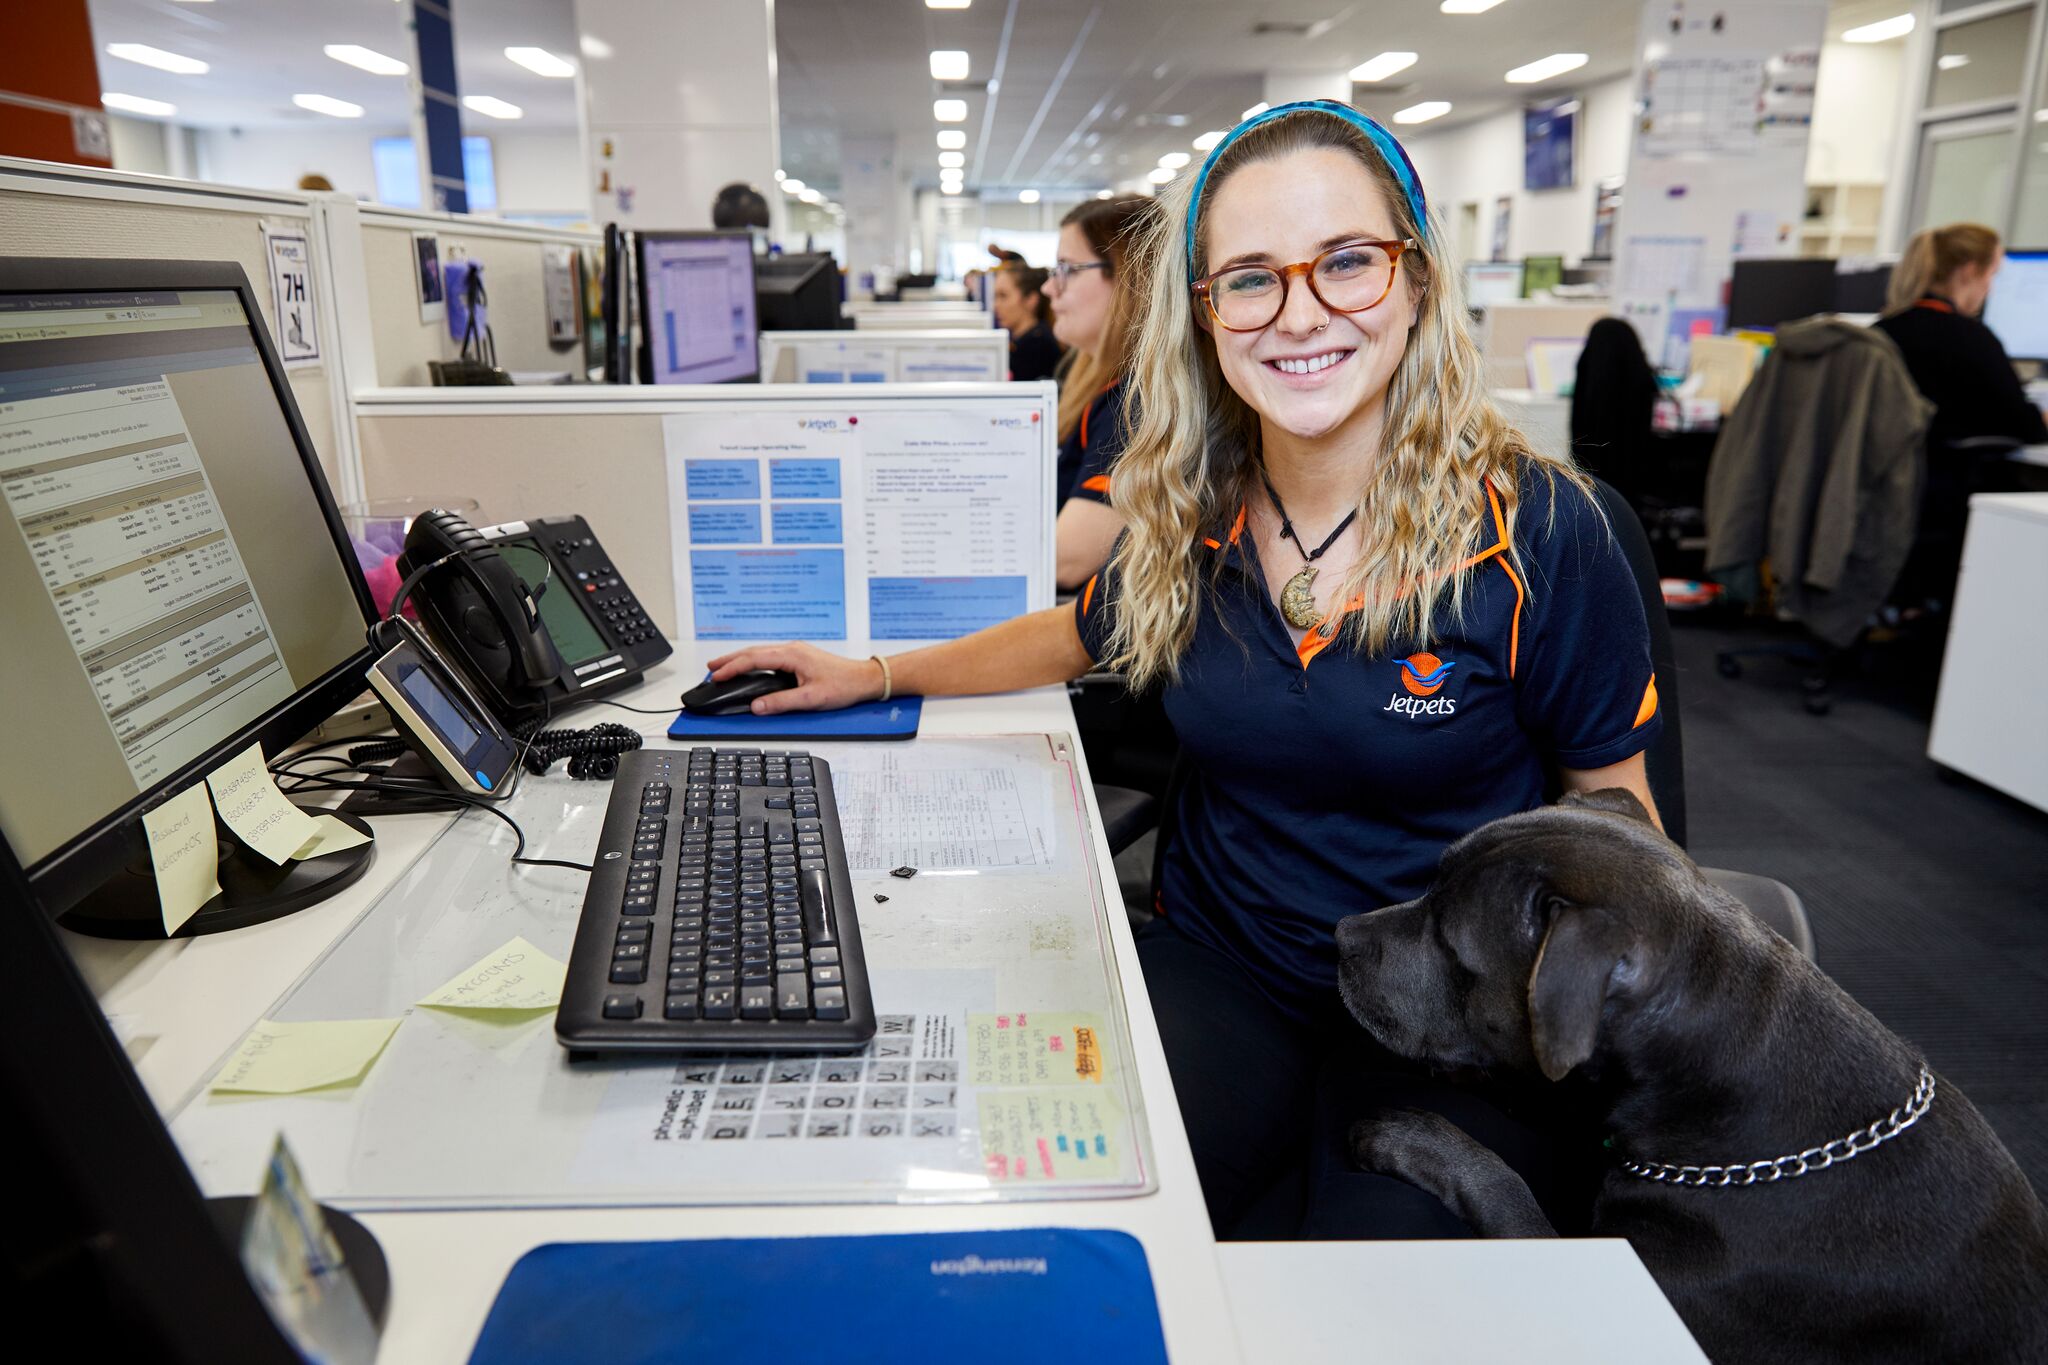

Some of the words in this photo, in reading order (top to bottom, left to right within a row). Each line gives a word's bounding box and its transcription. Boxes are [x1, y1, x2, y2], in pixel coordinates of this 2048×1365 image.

[282, 273, 306, 302] 7H
[884, 1021, 903, 1034] W
[880, 1048, 900, 1058] V
[686, 1072, 706, 1082] A
[731, 1074, 751, 1084] F
[781, 1072, 802, 1082] K
[827, 1073, 847, 1082] P
[877, 1072, 897, 1082] U
[926, 1073, 946, 1082] Z
[724, 1100, 746, 1110] E
[775, 1100, 794, 1109] J
[874, 1099, 895, 1109] T
[924, 1099, 944, 1108] Y
[654, 1089, 685, 1140] phonetic
[678, 1088, 707, 1140] alphabet
[713, 1128, 736, 1139] D
[817, 1126, 839, 1136] N
[870, 1126, 891, 1136] S
[922, 1125, 943, 1137] X
[930, 1253, 1047, 1277] Kensington
